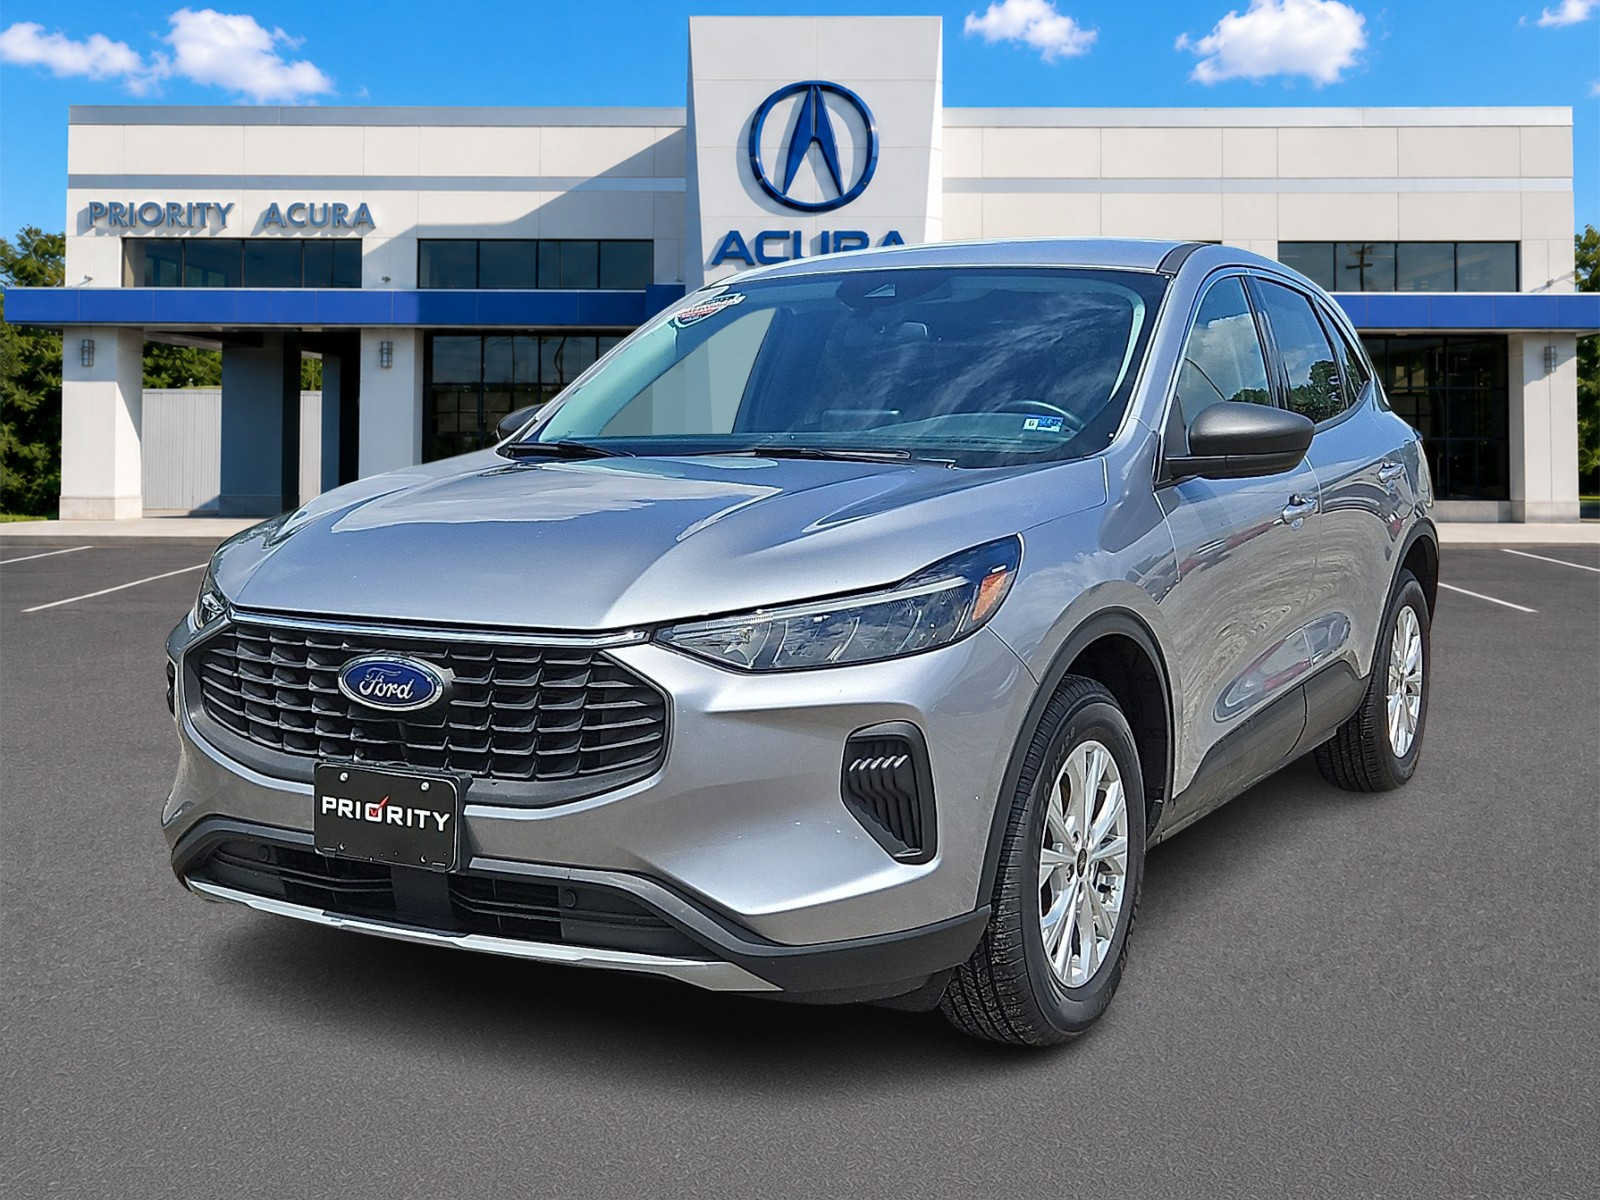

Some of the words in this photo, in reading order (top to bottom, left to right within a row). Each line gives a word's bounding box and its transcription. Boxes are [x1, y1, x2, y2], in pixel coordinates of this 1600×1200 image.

[88, 201, 235, 228] PRIORITY
[262, 201, 377, 229] ACURA
[359, 668, 415, 700] Ford
[321, 796, 451, 832] PRIORITY
